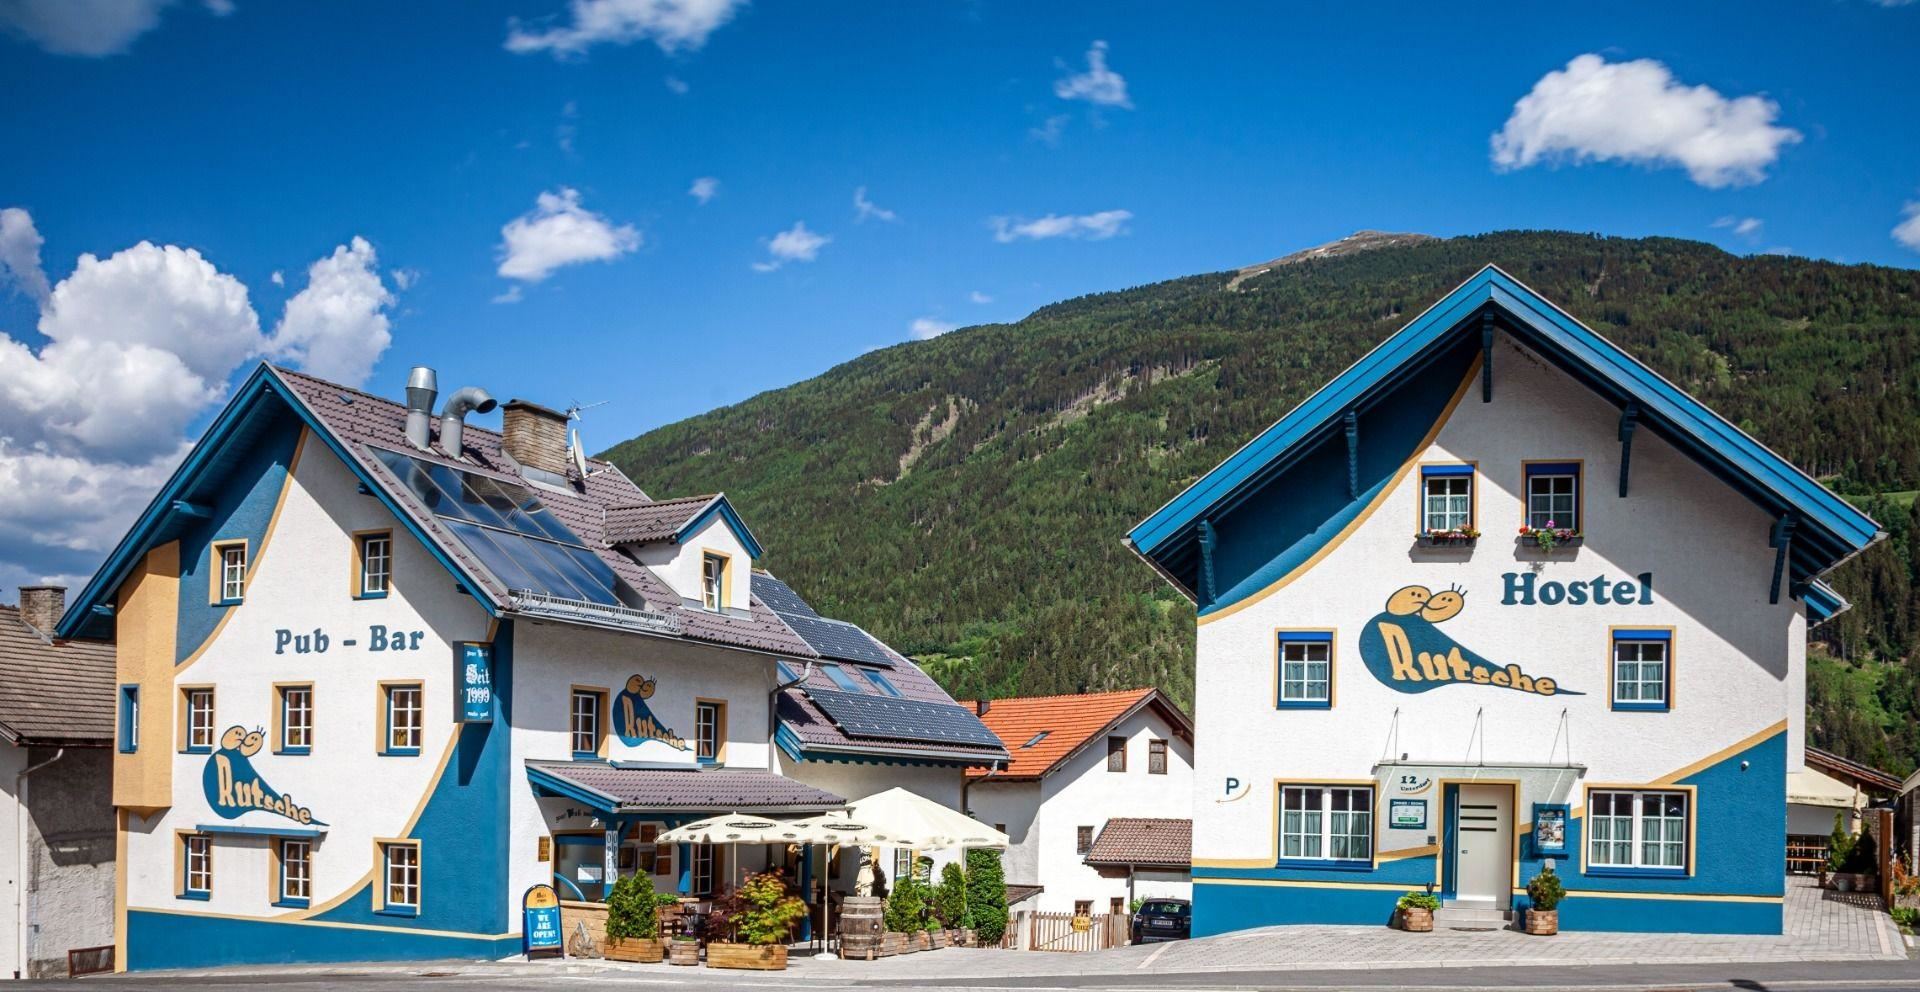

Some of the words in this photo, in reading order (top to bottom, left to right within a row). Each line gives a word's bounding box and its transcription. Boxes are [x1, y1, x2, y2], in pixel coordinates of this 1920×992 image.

[1501, 572, 1654, 606] Hostel
[275, 628, 330, 655] Pub
[368, 624, 425, 652] Bar
[1377, 621, 1558, 696] Rutsche
[465, 663, 491, 685] Seit
[466, 687, 490, 704] 1999
[621, 694, 686, 752] Rutsche
[214, 753, 312, 825] Rutsche
[1226, 777, 1240, 796] P
[1401, 776, 1417, 784] 12
[536, 922, 552, 930] ARE
[537, 914, 549, 922] WE
[533, 930, 556, 938] OPEN!
